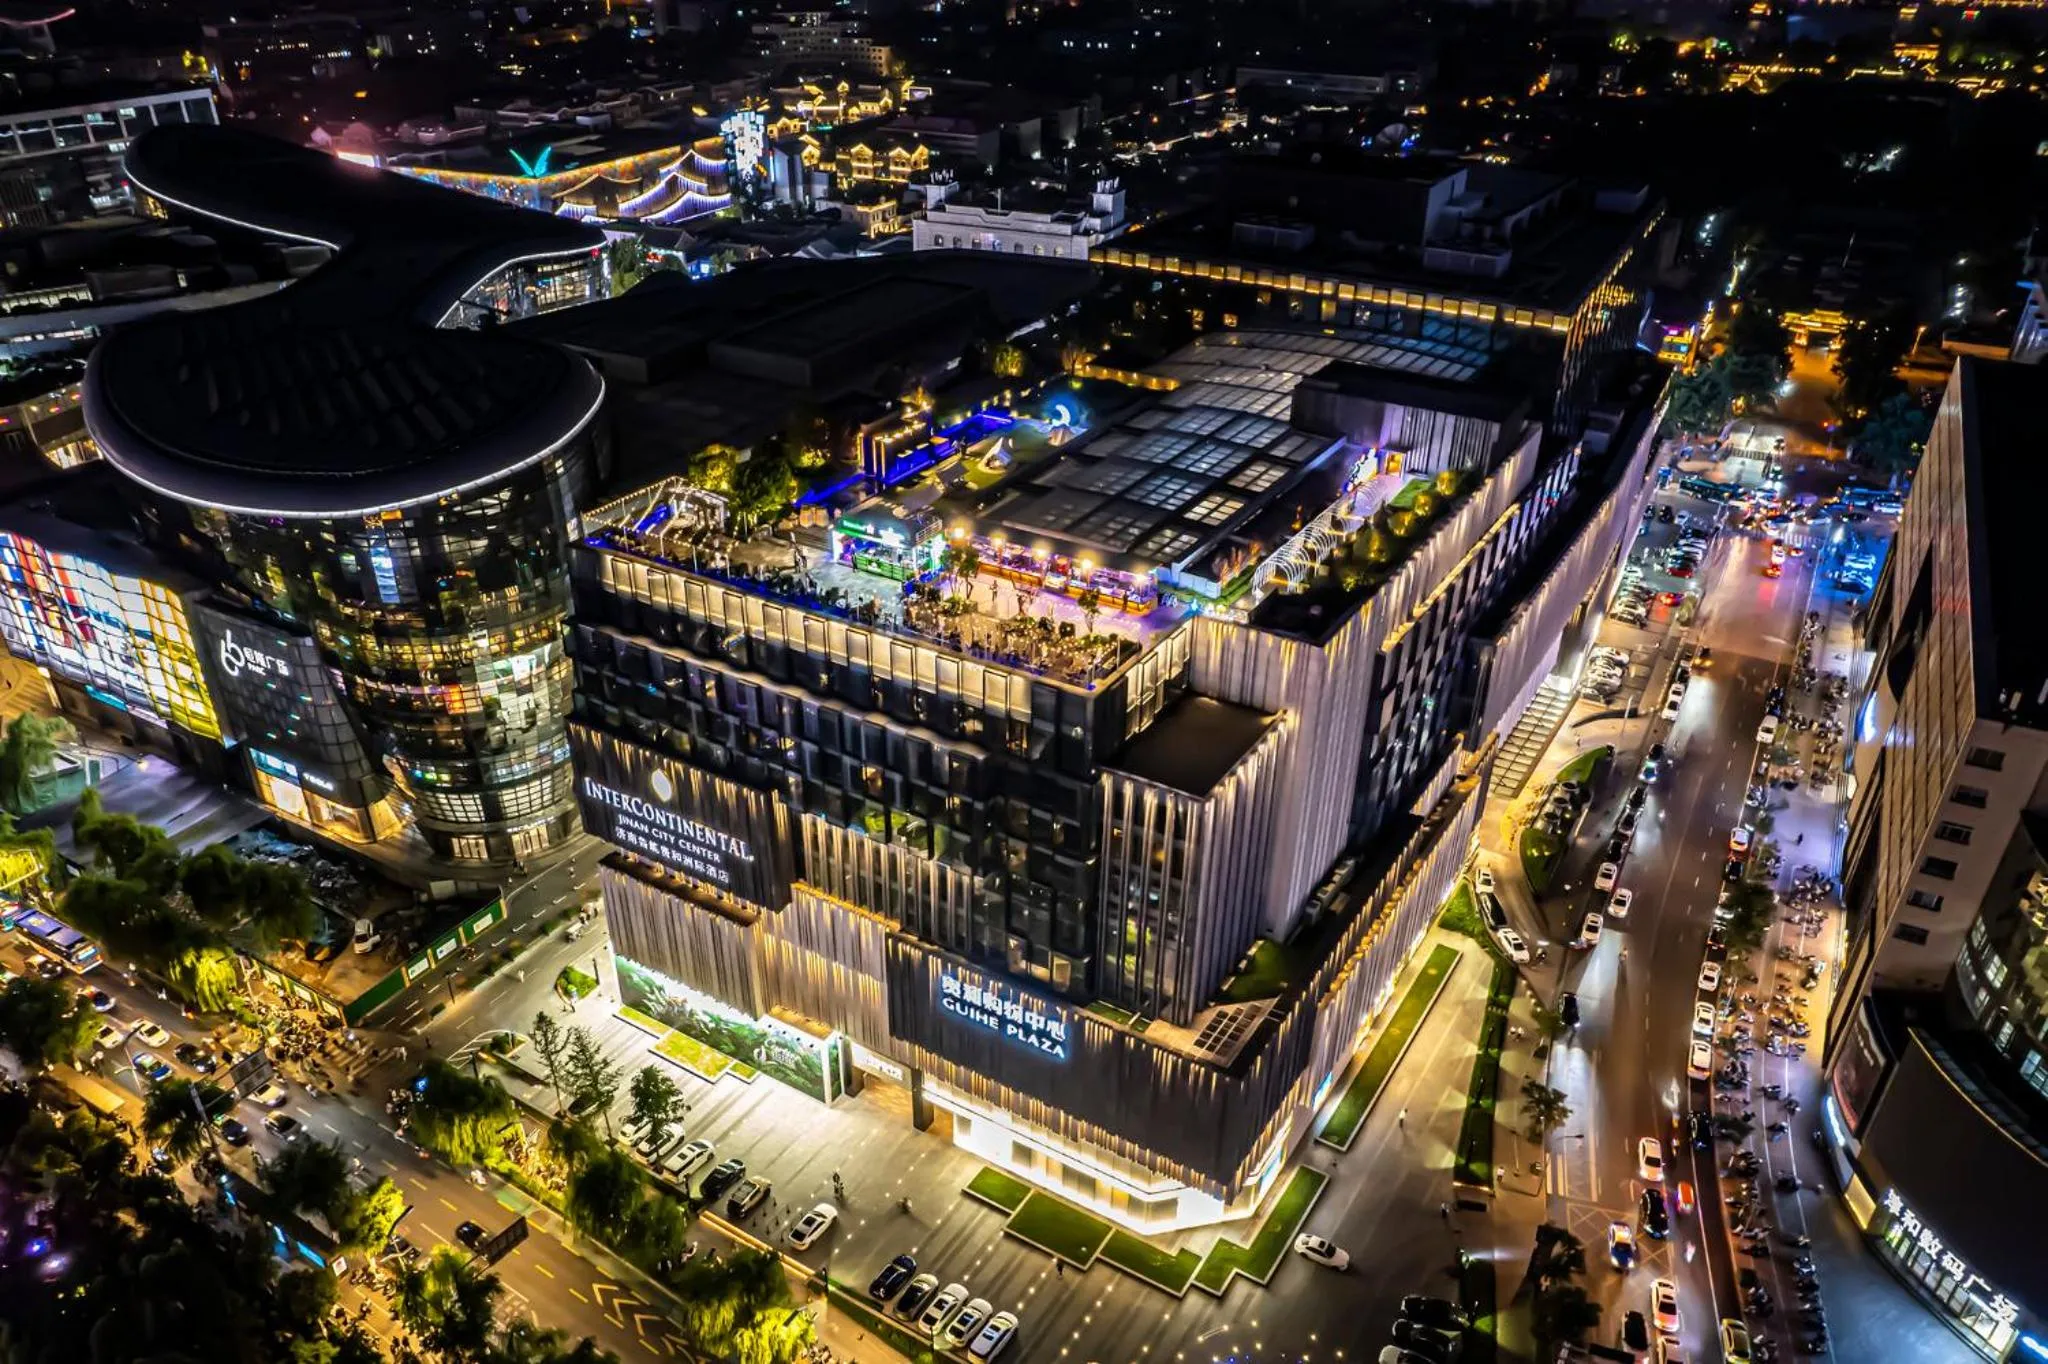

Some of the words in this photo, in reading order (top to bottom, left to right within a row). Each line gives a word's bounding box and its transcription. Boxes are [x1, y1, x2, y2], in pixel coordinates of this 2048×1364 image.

[618, 814, 650, 834] JINAN
[652, 827, 676, 845] CITY
[678, 838, 721, 864] CENTER
[942, 997, 1000, 1031] GUIHE
[1006, 1026, 1066, 1060] PLAZA
